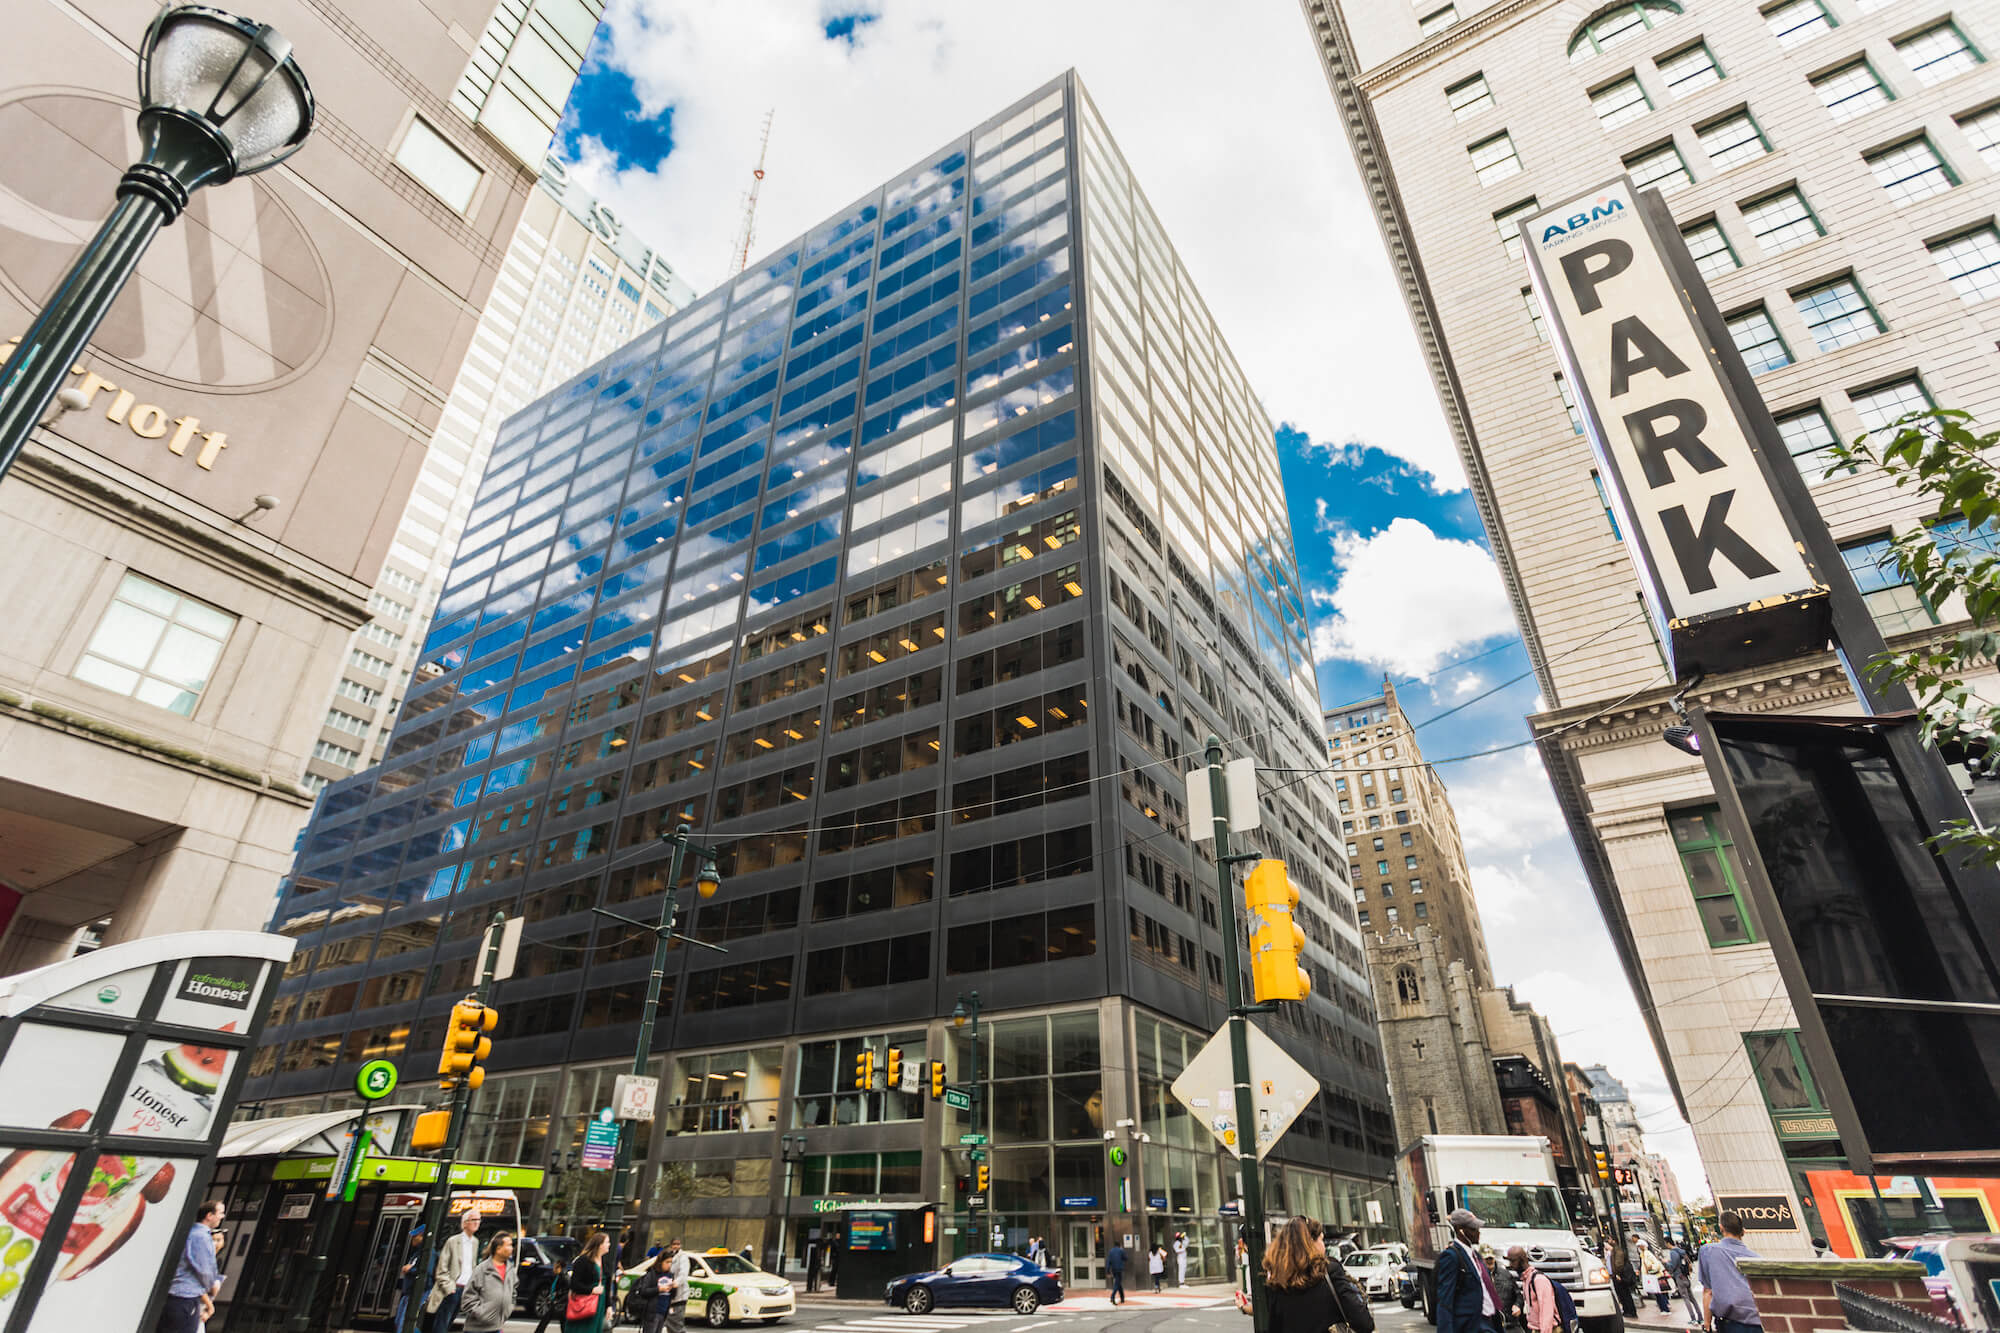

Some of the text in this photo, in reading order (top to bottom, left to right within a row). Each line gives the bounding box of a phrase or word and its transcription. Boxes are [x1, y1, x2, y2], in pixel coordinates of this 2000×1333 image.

[1542, 199, 1624, 243] ABM
[1559, 238, 1781, 595] PARK
[185, 980, 249, 1001] Honest
[907, 1065, 917, 1076] NO
[130, 1086, 190, 1127] Honest
